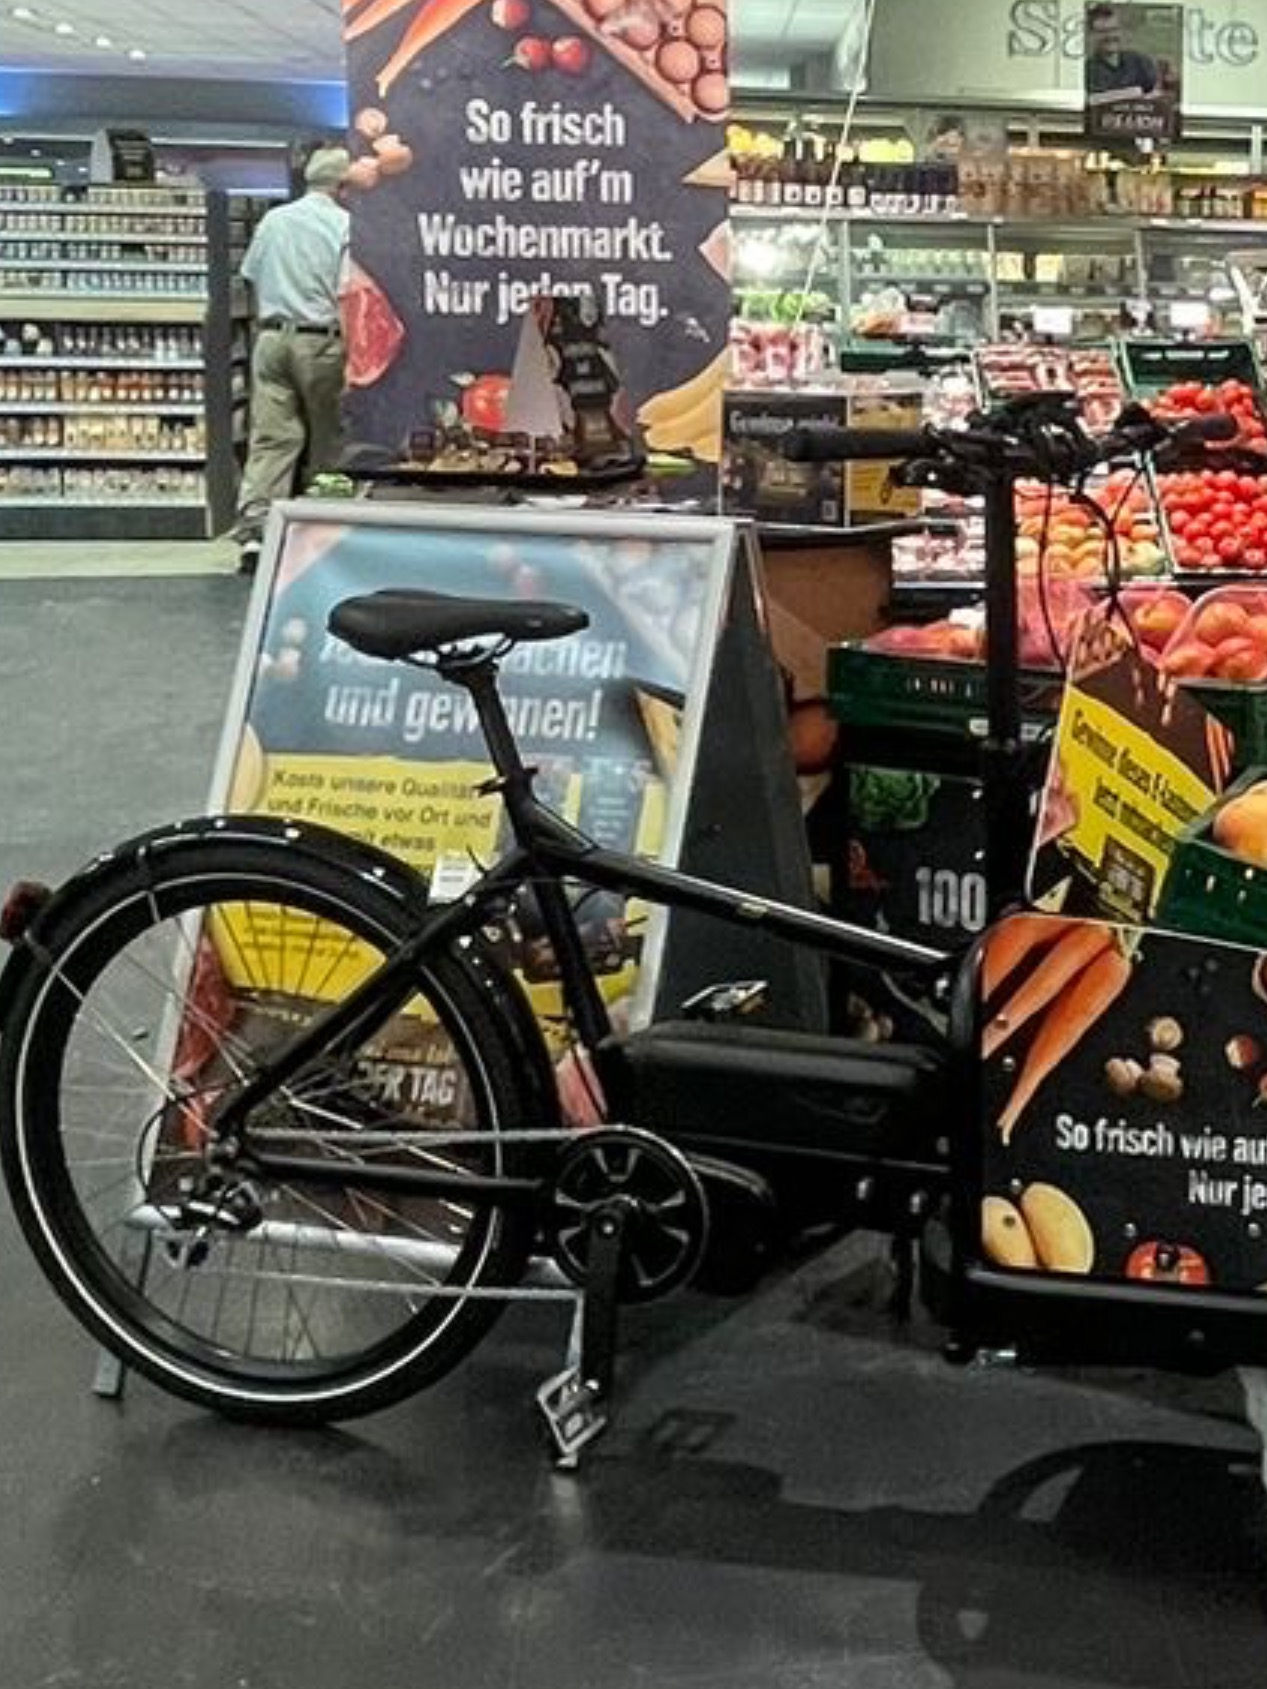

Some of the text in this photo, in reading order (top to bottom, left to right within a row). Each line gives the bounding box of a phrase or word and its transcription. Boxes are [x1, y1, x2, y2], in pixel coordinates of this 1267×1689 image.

[1008, 0, 1259, 66] Sate
[465, 98, 626, 146] So frisch
[459, 159, 632, 205] wie auf'm
[418, 212, 674, 261] Wochenmarkt.
[424, 271, 490, 315] Nur
[600, 273, 669, 327] Tag.
[323, 677, 603, 742] und gewnen!
[331, 776, 397, 796] unsere
[307, 797, 378, 819] Frische
[383, 805, 414, 822] vor
[421, 804, 449, 826] Ort
[454, 810, 493, 829] und
[1055, 1114, 1090, 1150] So
[1094, 1117, 1175, 1157] frisch
[1179, 1125, 1227, 1162] wie
[1187, 1168, 1239, 1207] Nur
